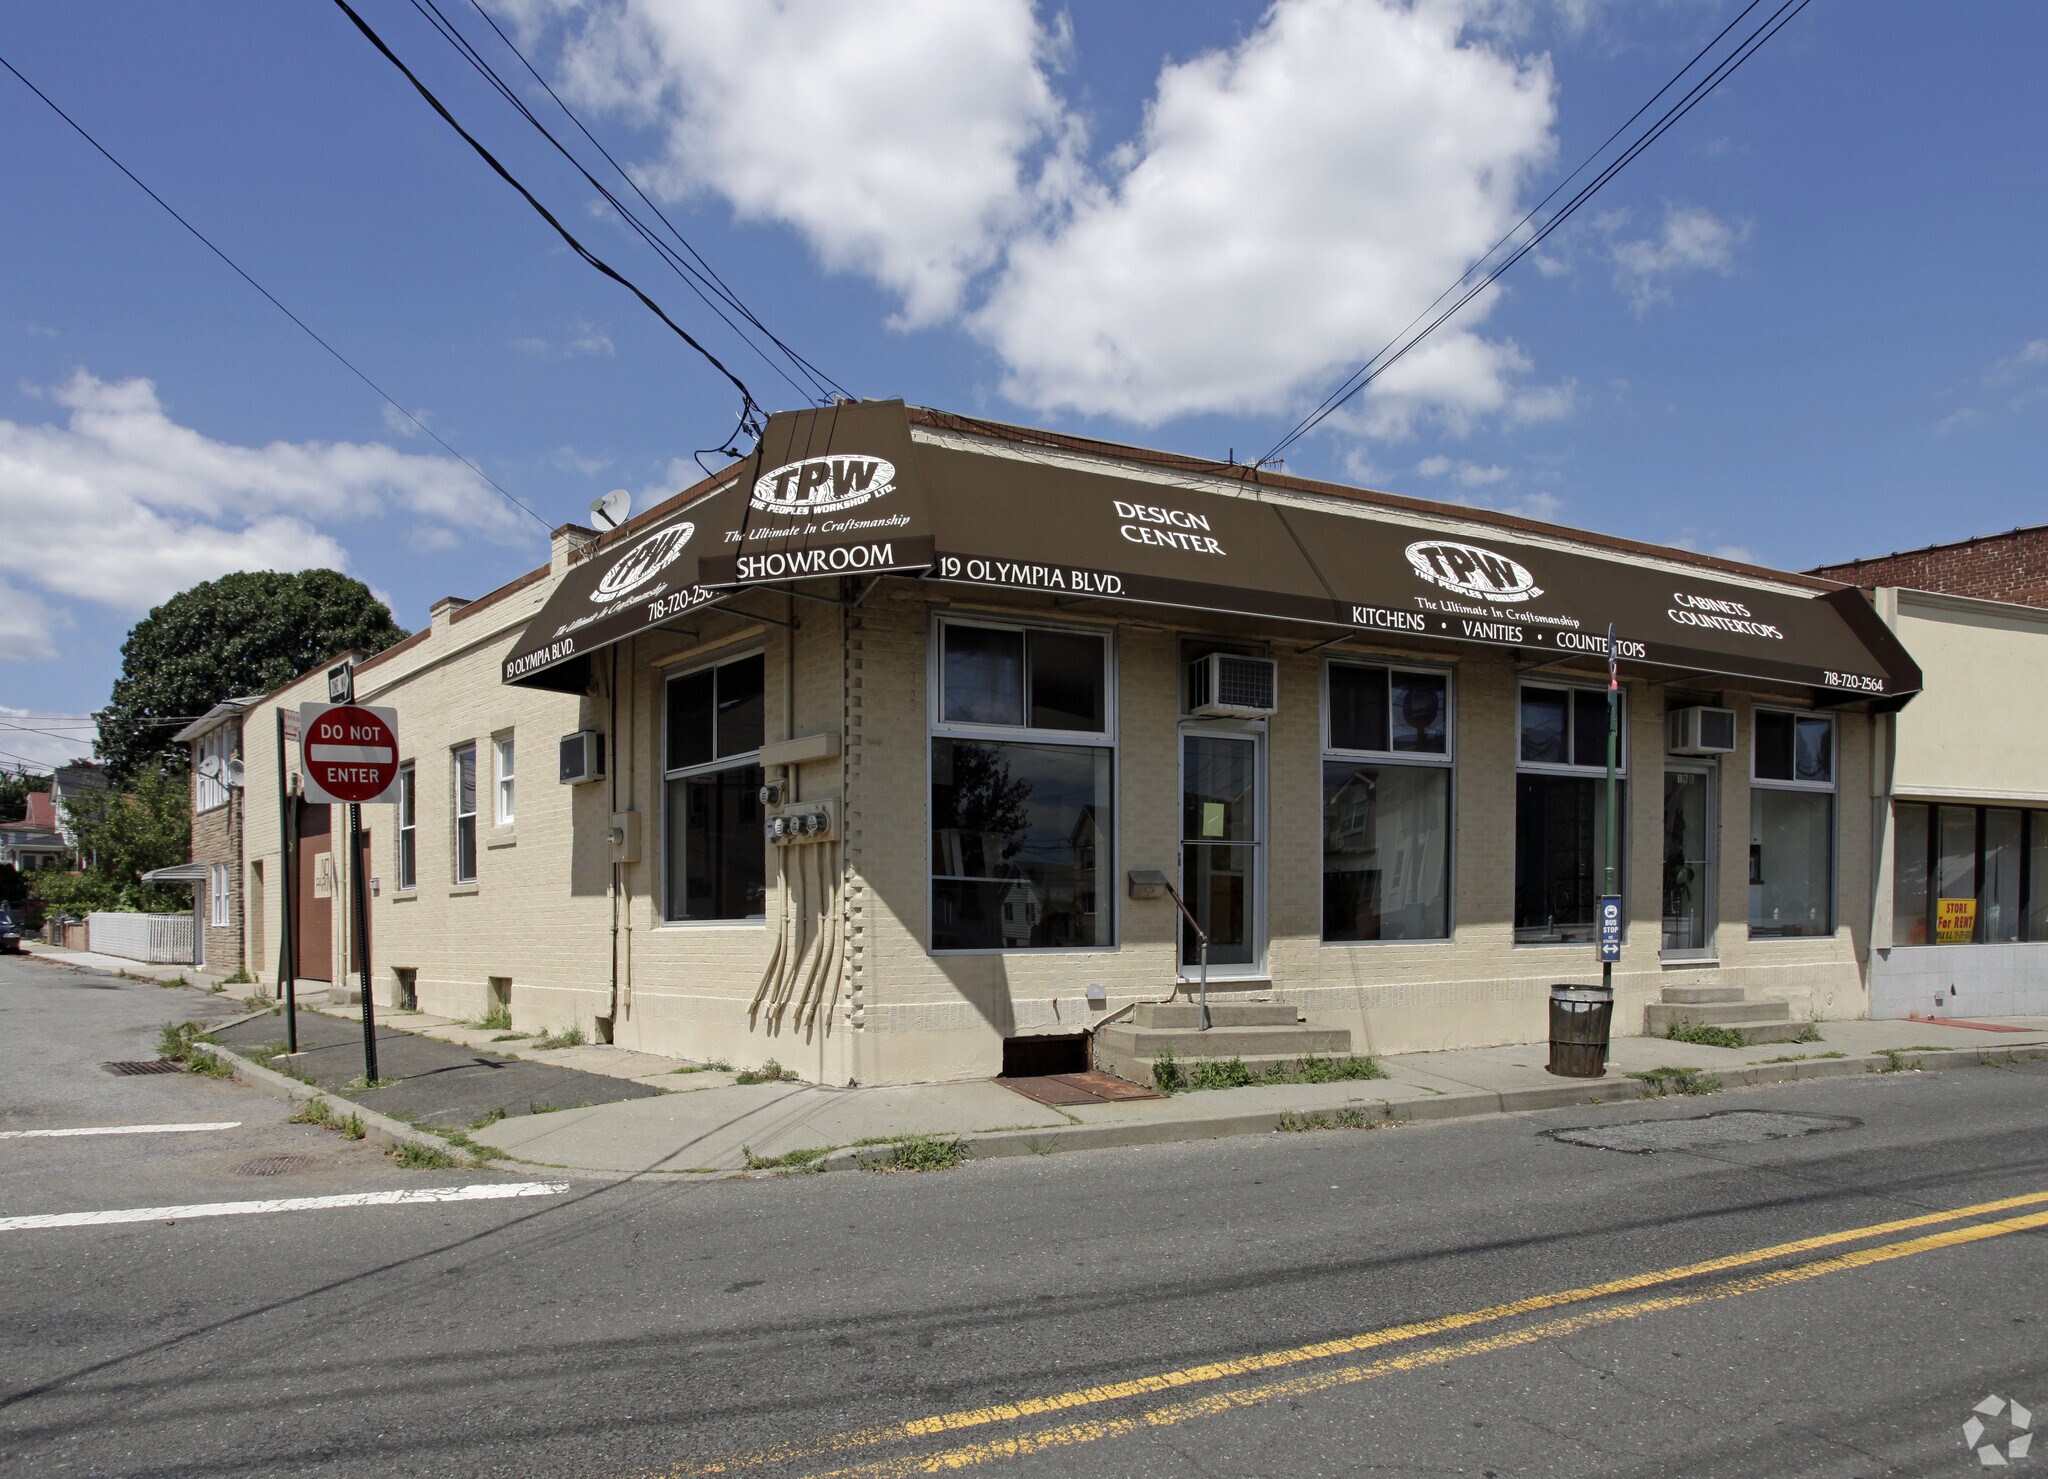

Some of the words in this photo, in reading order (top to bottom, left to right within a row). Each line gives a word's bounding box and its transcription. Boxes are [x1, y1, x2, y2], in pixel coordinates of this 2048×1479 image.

[770, 460, 879, 503] TPW
[749, 498, 766, 512] THE
[767, 503, 809, 515] PEOPLES
[813, 494, 872, 514] WORKSHOP
[874, 484, 897, 499] LTD.
[723, 530, 745, 543] The
[749, 525, 800, 541] Ultimate
[803, 522, 817, 535] In
[821, 513, 911, 533] Craftsmanship
[1113, 500, 1211, 532] DESIGN
[1120, 525, 1227, 556] CENTER
[736, 543, 895, 579] SHOWROOM
[939, 556, 962, 578] 19
[967, 559, 1067, 590] OLYMPIA
[1071, 571, 1126, 596] BLVD.
[1416, 545, 1522, 591] TPW
[1413, 567, 1435, 584] THE
[1438, 579, 1483, 600] PEOPLES
[1483, 592, 1530, 603] WORKSHOP
[1414, 596, 1438, 610] The
[1440, 600, 1488, 617] Ultimate
[1490, 606, 1504, 619] In
[1506, 608, 1580, 629] Craftsmanship
[1673, 592, 1751, 618] CABINETS
[1352, 605, 1425, 631] KITCHENS
[1462, 619, 1523, 643] VANITIES
[1556, 631, 1646, 658] COUNTETOPS
[1667, 608, 1784, 640] COUNTERTOPS
[506, 661, 514, 679] 19
[515, 647, 551, 675] OLYMPIA
[551, 638, 575, 660] BLVD.
[1823, 670, 1884, 692] 718-720-2564
[321, 724, 343, 739] DO
[350, 725, 381, 741] NOT
[327, 767, 379, 783] ENTER
[1938, 916, 1951, 928] For
[1954, 916, 1973, 928] RENT
[1946, 902, 1967, 913] STORE
[1603, 926, 1619, 934] STOP
